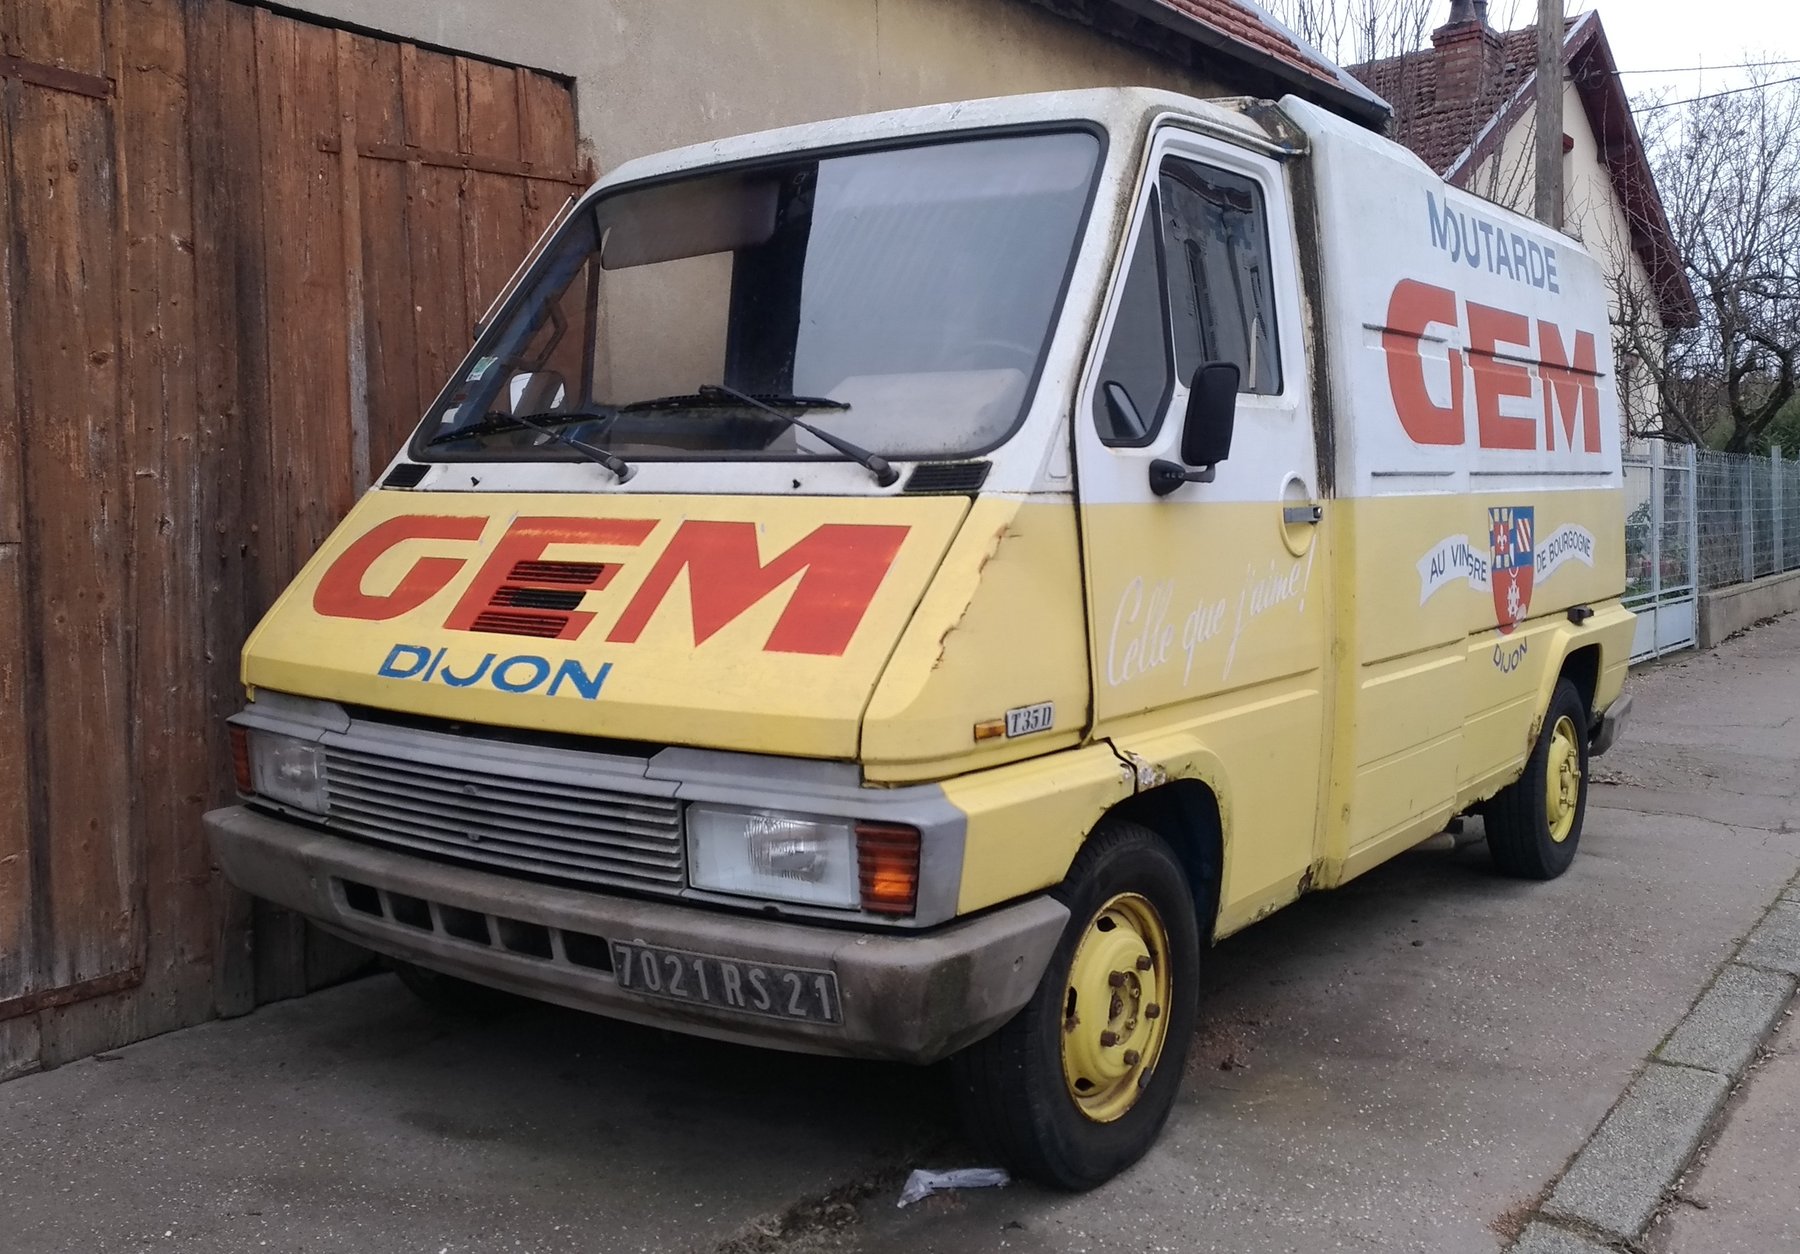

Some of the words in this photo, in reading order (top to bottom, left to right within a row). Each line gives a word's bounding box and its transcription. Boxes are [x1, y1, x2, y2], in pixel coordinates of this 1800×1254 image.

[1426, 189, 1560, 294] MOUTARDE
[1382, 278, 1602, 454] GEM
[312, 514, 910, 656] GEM
[1429, 548, 1446, 584] AU
[1536, 548, 1547, 574] DE
[1548, 530, 1591, 563] BOURGOGNE
[1107, 575, 1176, 687] Celle
[1182, 597, 1226, 687] que
[1493, 635, 1528, 674] DIJON
[377, 643, 614, 700] DIJON
[616, 946, 710, 1001] 7021
[721, 963, 771, 1011] RS
[783, 973, 832, 1020] 21
